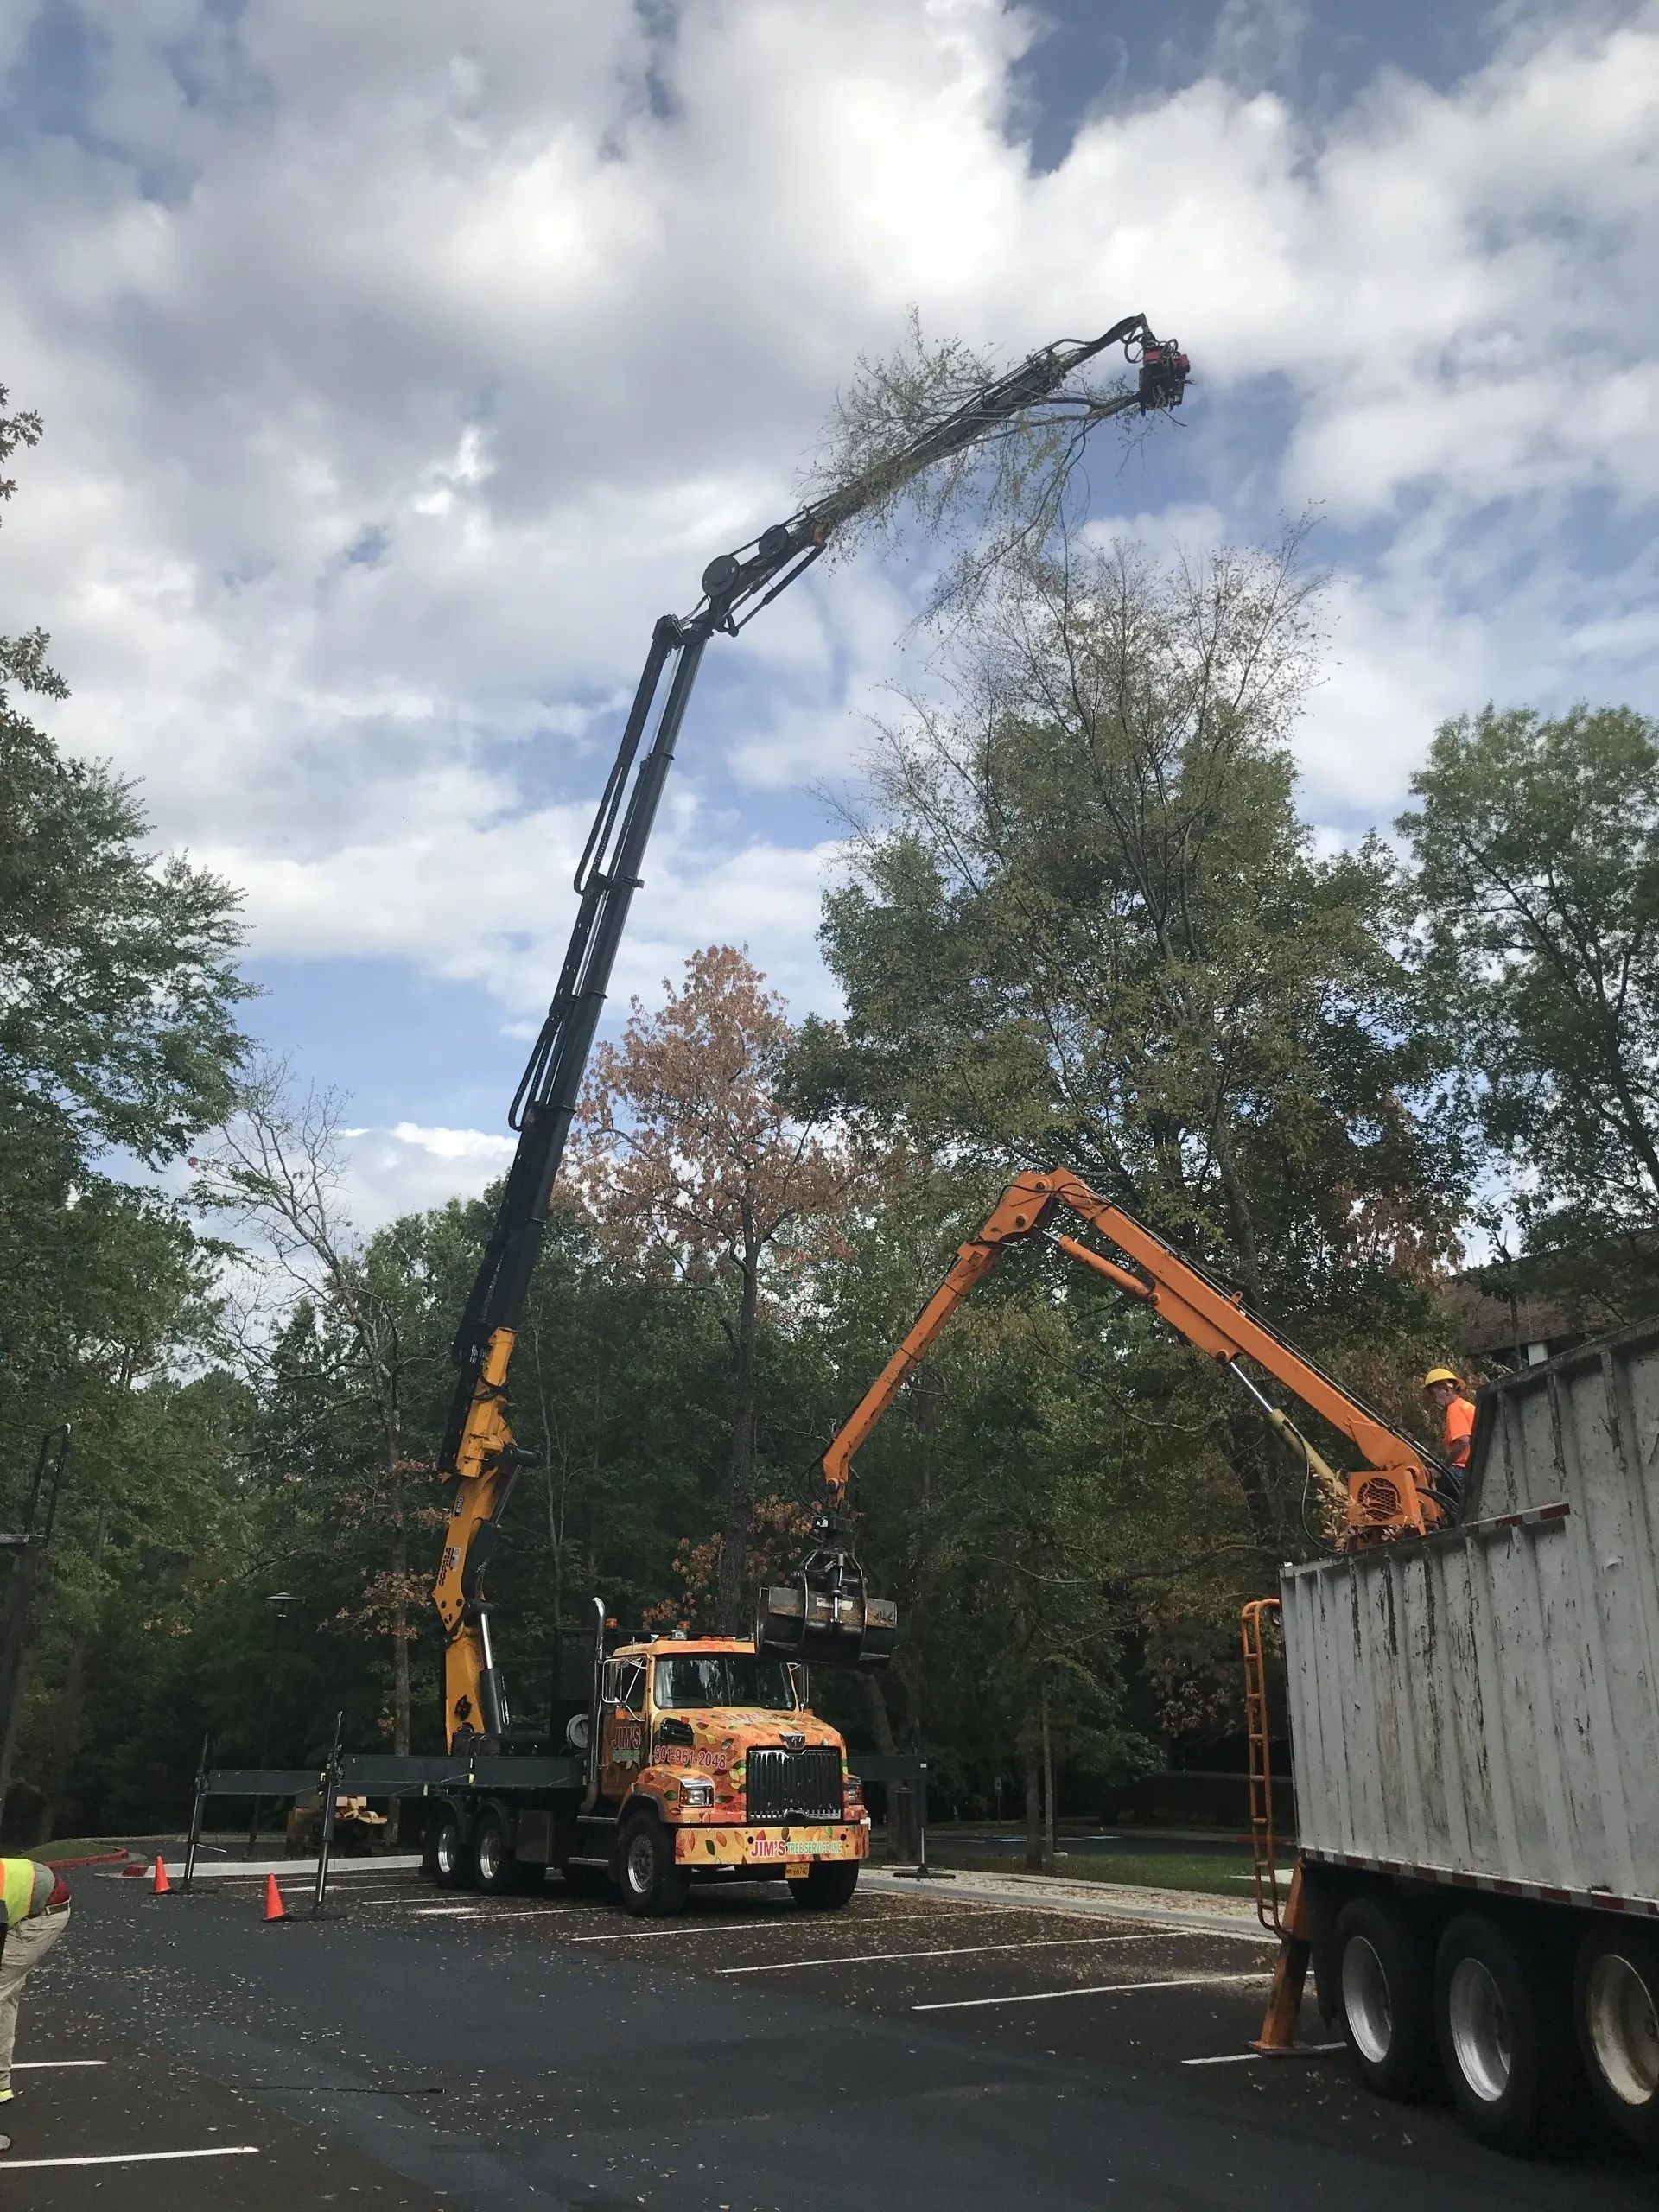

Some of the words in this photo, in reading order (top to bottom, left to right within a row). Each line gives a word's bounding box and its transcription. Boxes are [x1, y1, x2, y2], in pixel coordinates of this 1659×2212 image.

[455, 1497, 464, 1514] 650
[612, 1726, 641, 1750] JIM'S
[654, 1745, 727, 1770] 501-961-2048
[751, 1841, 786, 1857] JIM'S
[787, 1842, 804, 1854] TREE
[804, 1841, 830, 1854] SERVICE
[831, 1840, 842, 1853] INC
